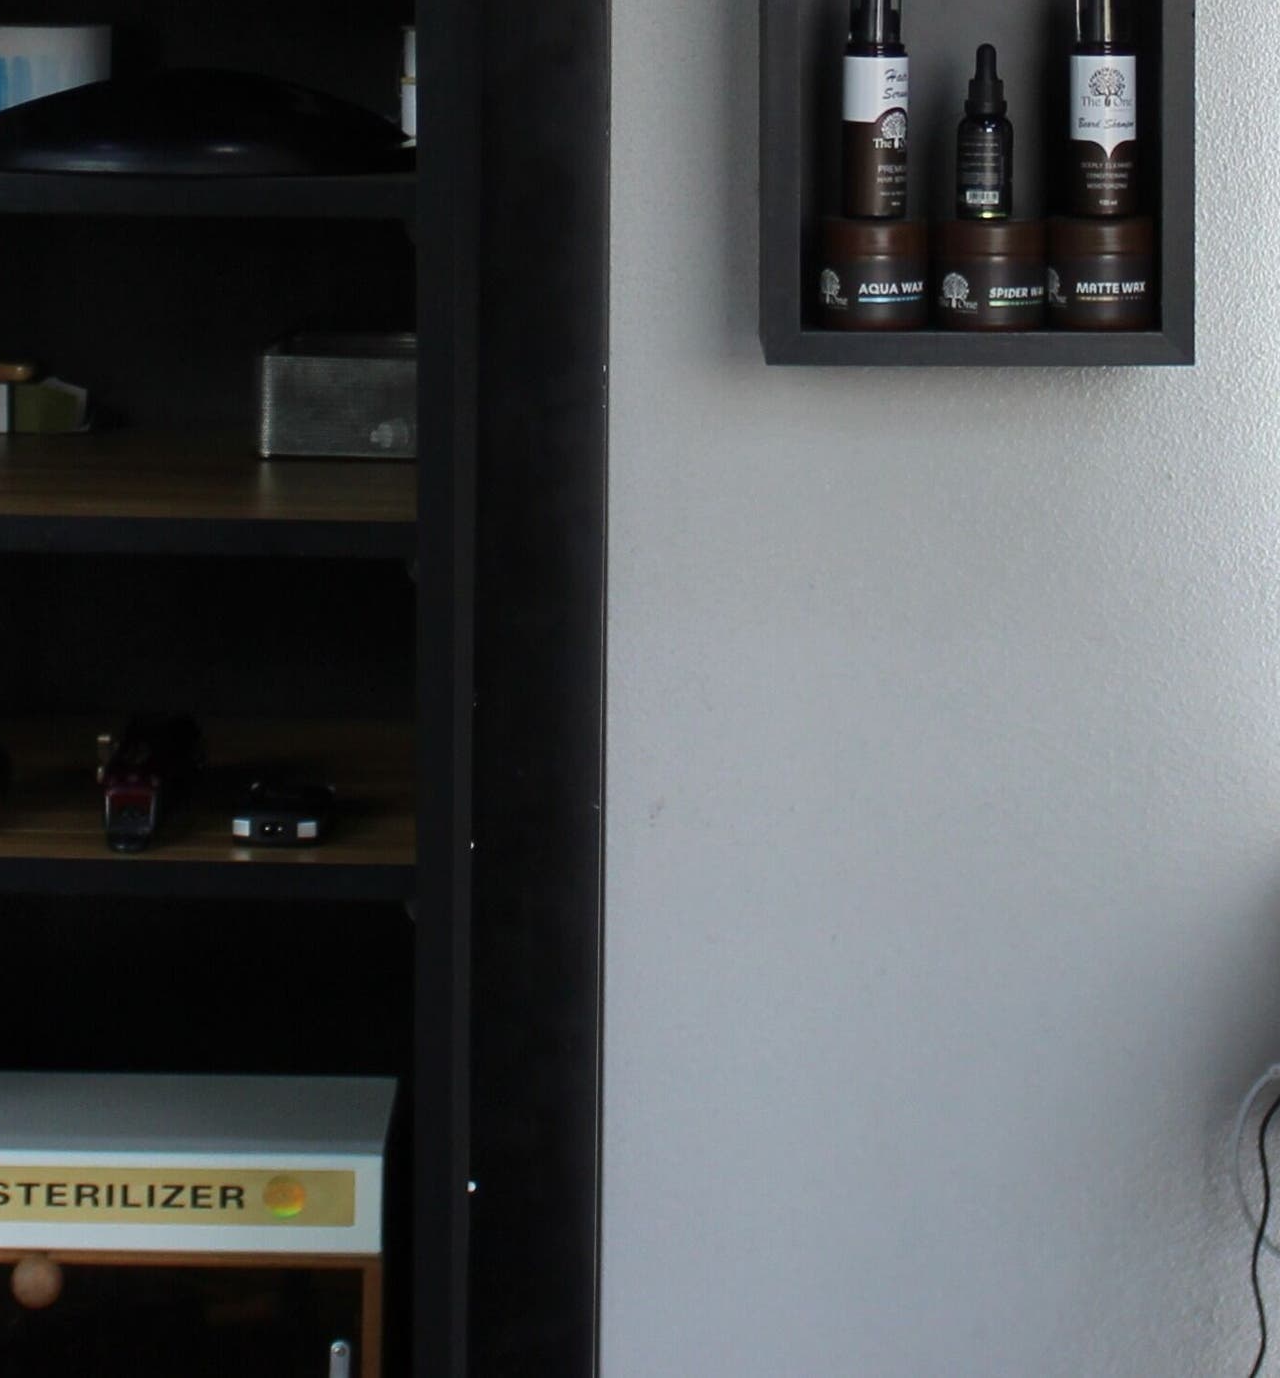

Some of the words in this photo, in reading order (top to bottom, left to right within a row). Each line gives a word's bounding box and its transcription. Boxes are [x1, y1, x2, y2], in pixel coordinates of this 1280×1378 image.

[873, 138, 892, 149] The
[858, 283, 898, 295] AQUA
[901, 281, 923, 293] WAX
[989, 287, 1028, 299] SPIDER
[1076, 282, 1120, 294] MATTE
[1122, 281, 1145, 293] WAX
